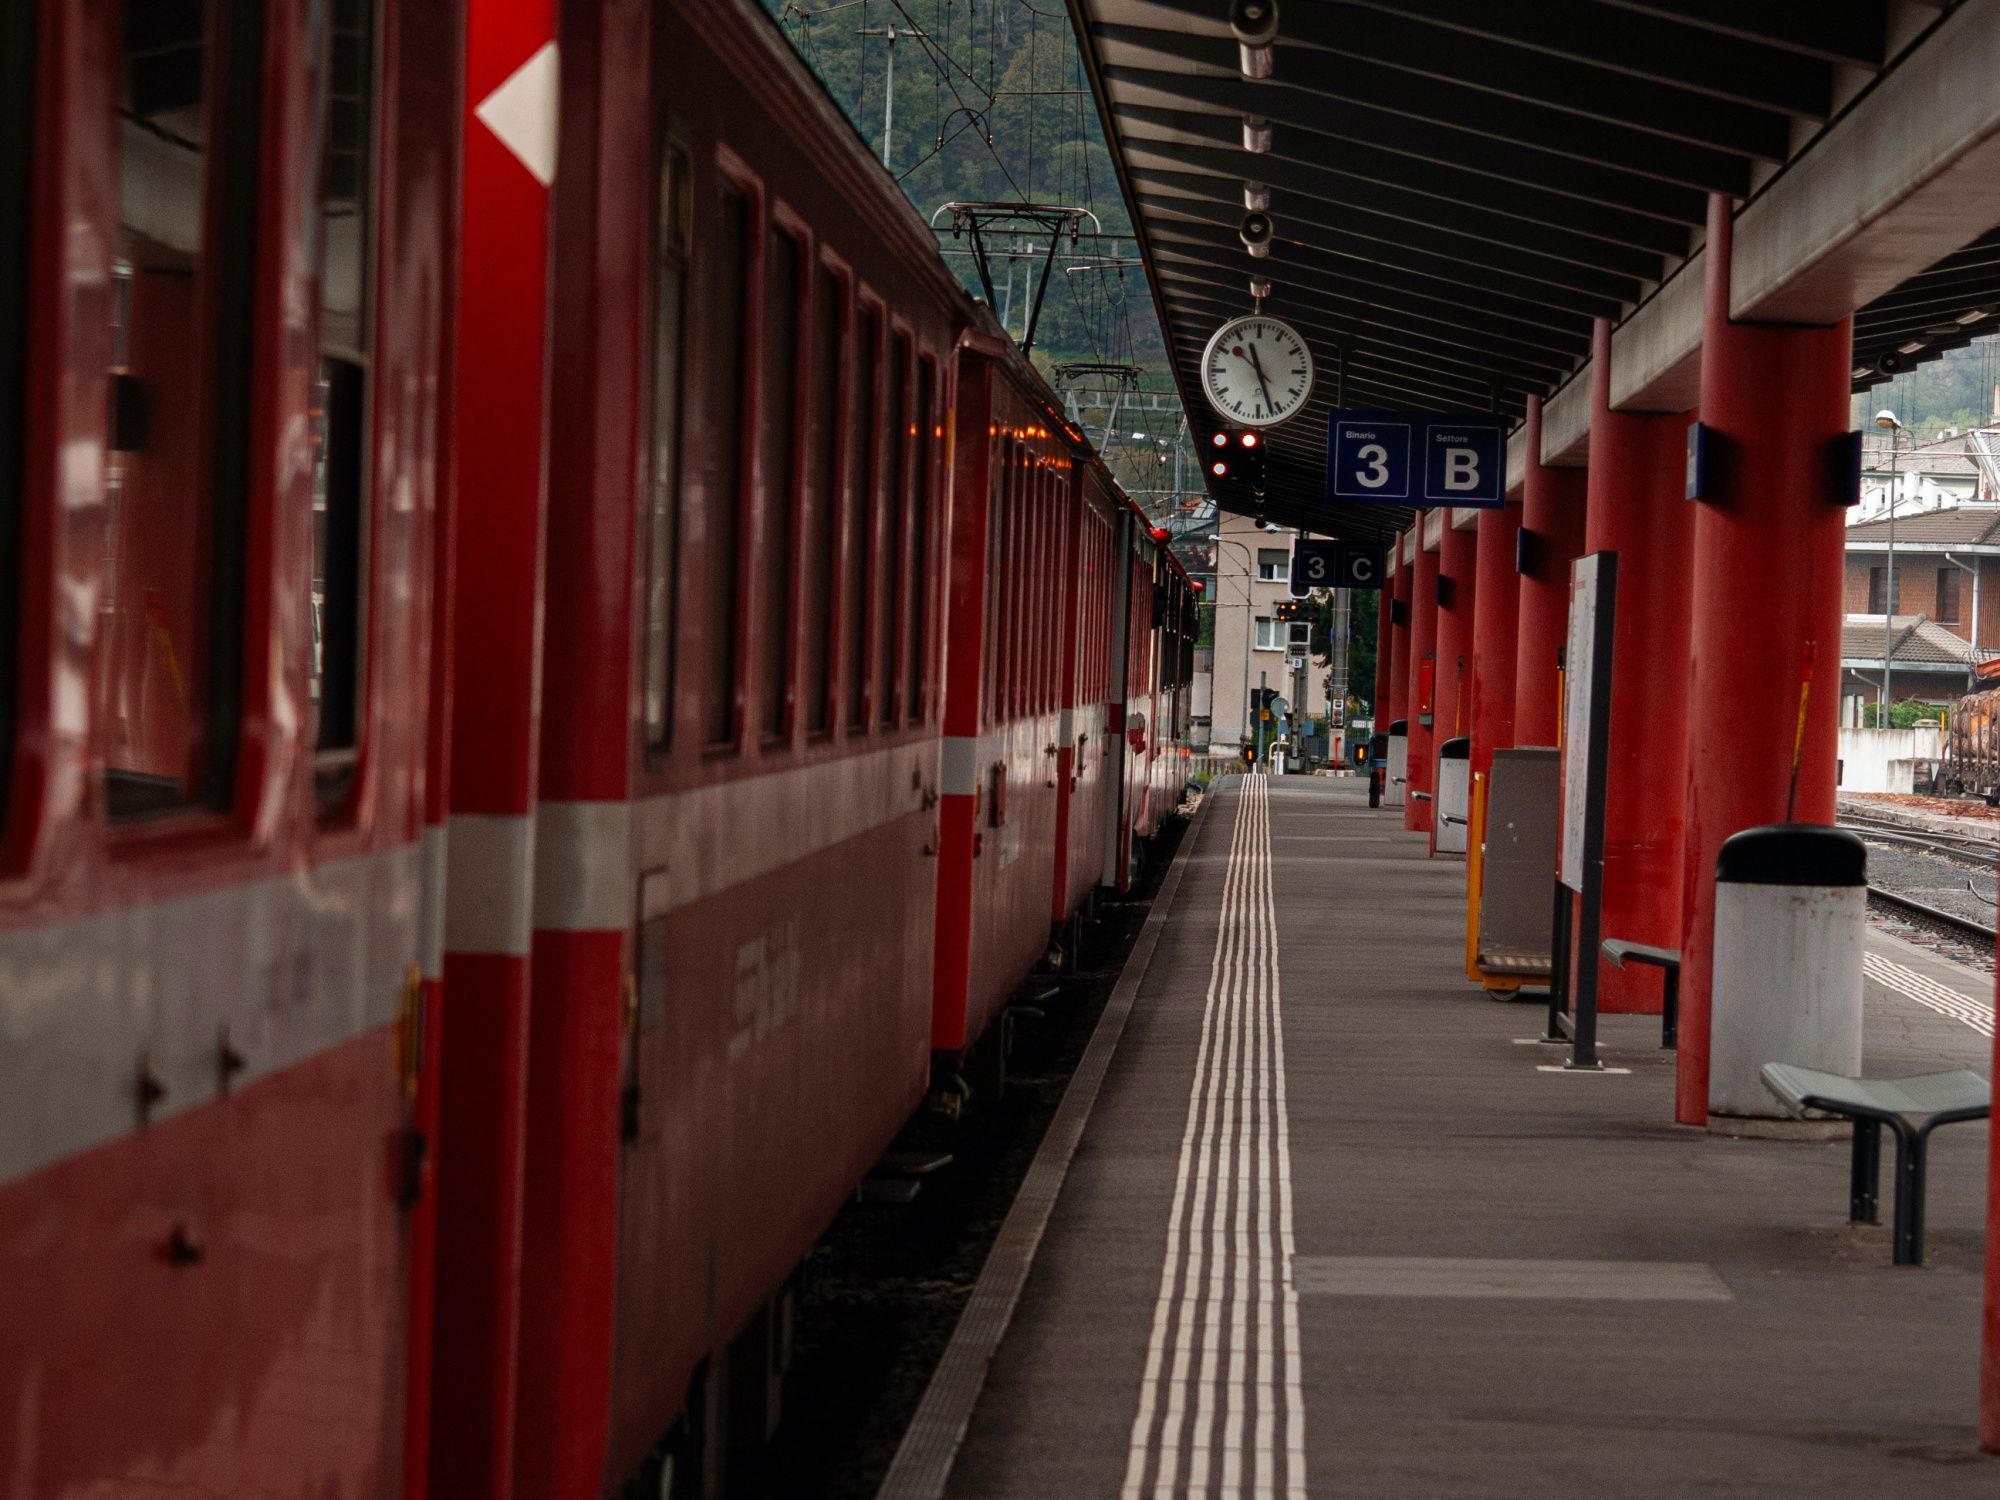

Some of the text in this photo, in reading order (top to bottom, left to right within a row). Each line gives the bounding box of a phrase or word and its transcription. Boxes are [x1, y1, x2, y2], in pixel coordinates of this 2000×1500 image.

[1346, 430, 1376, 440] Binario
[1436, 434, 1469, 443] Settore
[1356, 444, 1389, 488] 3
[1445, 448, 1480, 490] B
[1308, 556, 1325, 579] 3
[1352, 557, 1372, 581] C
